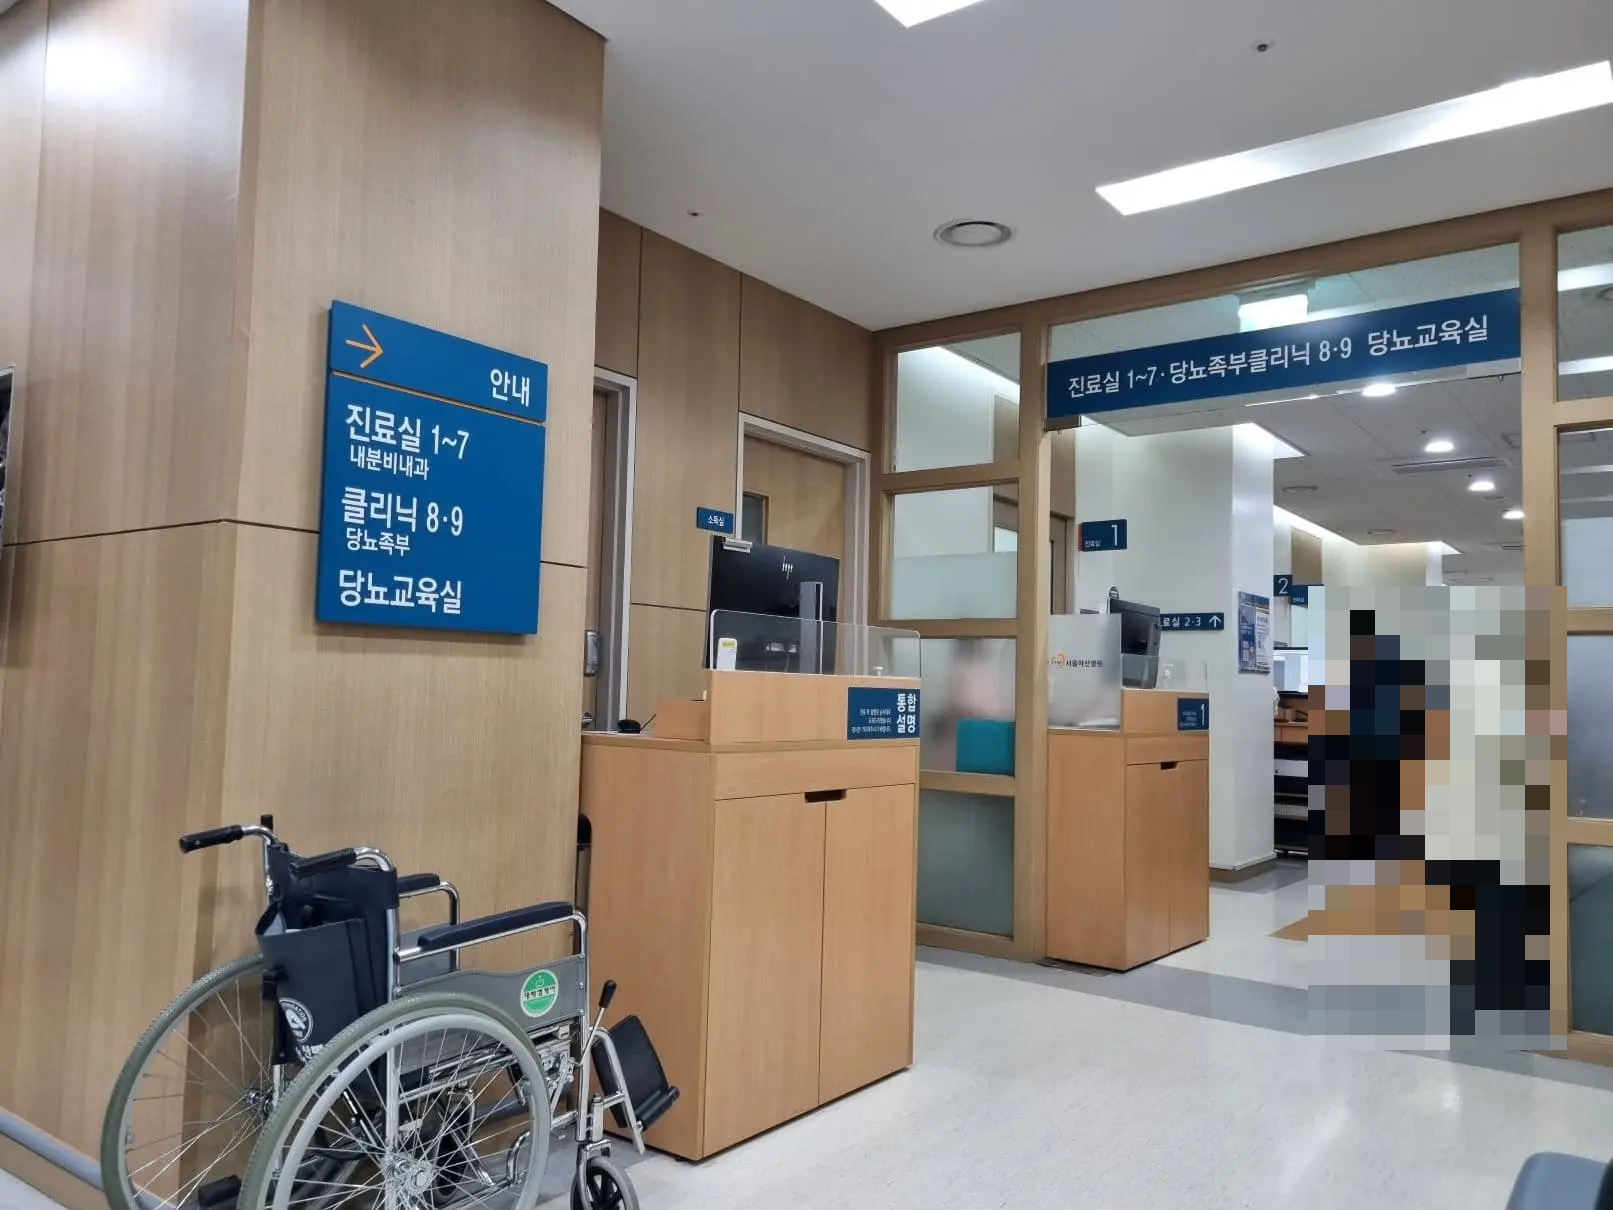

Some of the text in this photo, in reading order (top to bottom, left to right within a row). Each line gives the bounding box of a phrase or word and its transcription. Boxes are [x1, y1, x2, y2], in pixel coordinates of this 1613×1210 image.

[1068, 371, 1120, 398] 진료실
[1319, 337, 1352, 361] 8·9
[1367, 314, 1489, 357] 당뇨교육실
[490, 368, 530, 407] 안내
[345, 404, 470, 459] 진료실 1~7
[350, 444, 430, 481] 내분비내과
[341, 486, 463, 537] 클리닉 8·9
[345, 527, 410, 557] 당뇨족부
[1111, 524, 1118, 547] 1
[338, 569, 462, 615] 당뇨교육실
[1278, 577, 1289, 594] 2
